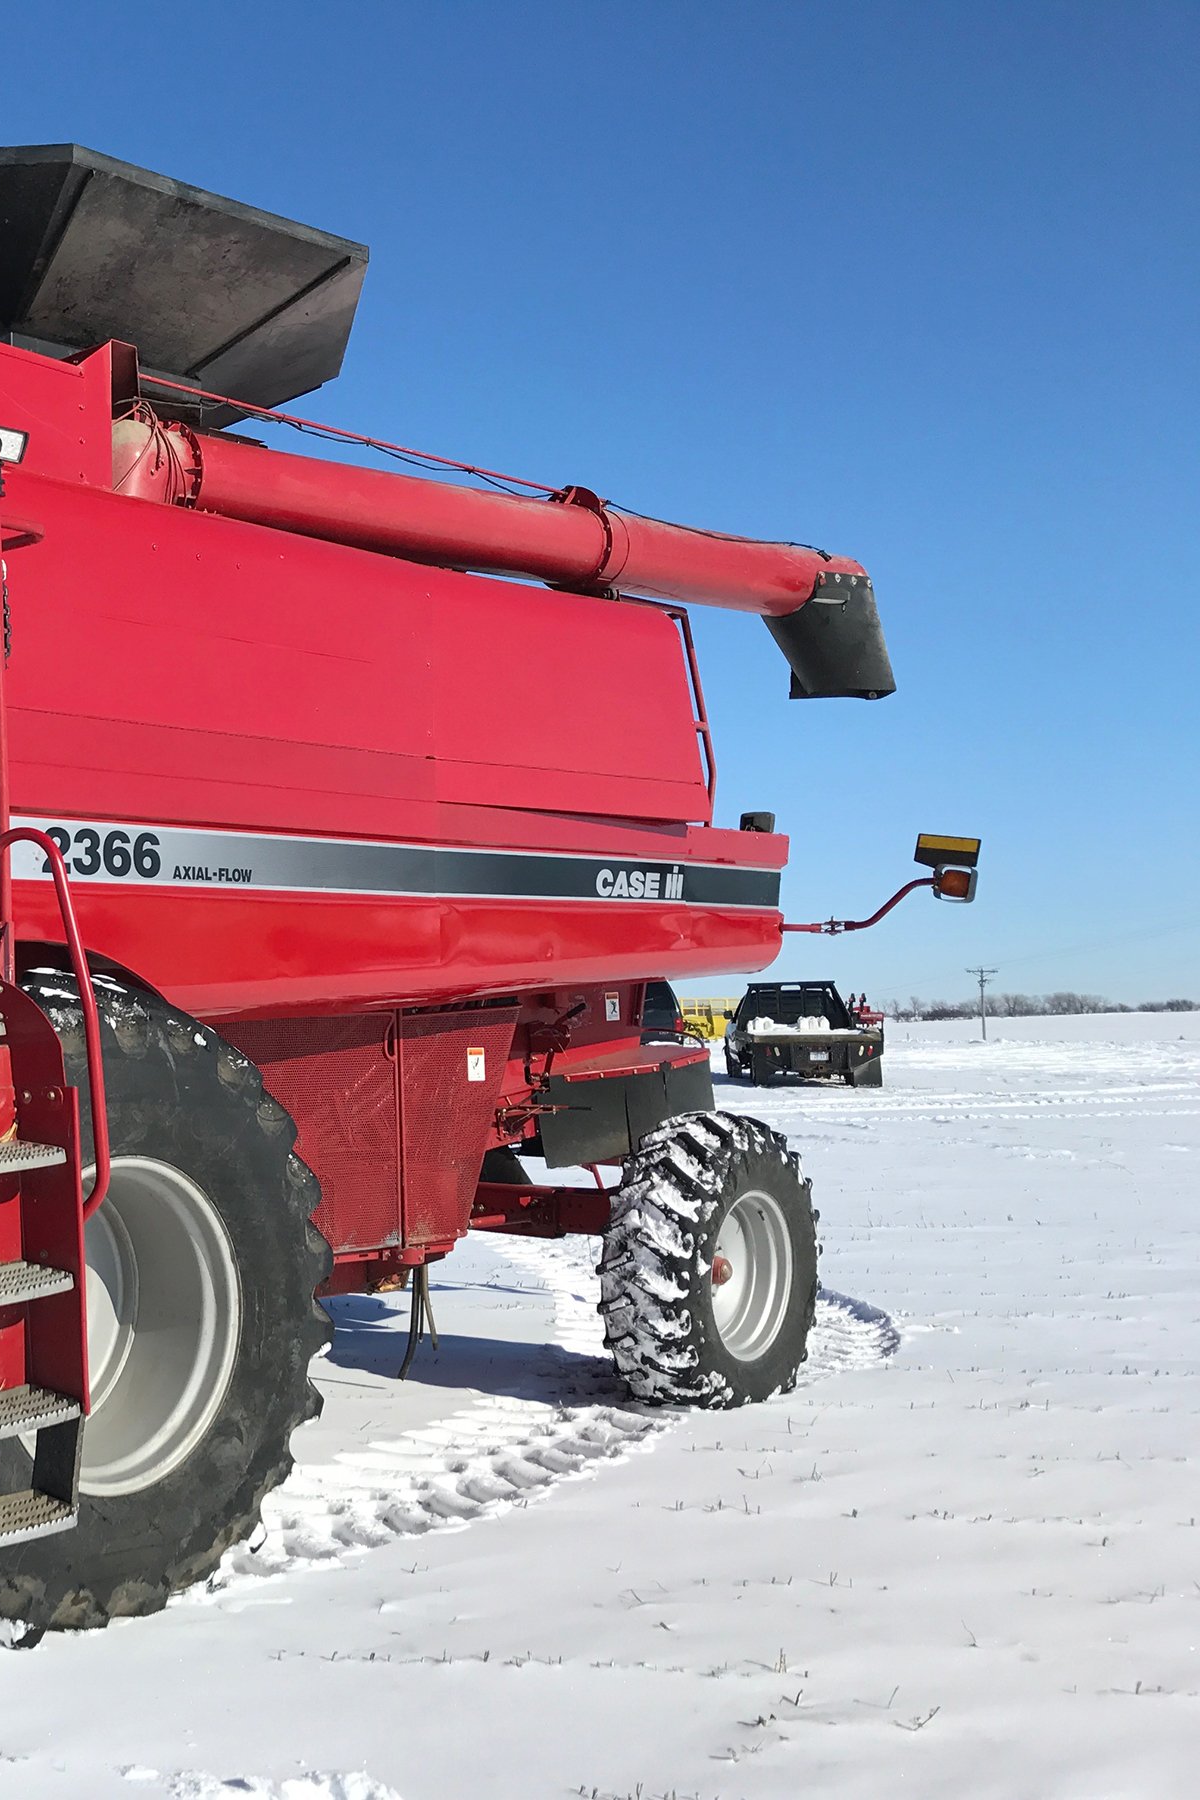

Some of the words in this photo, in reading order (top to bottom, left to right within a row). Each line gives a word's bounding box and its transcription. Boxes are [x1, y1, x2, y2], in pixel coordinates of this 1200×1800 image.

[42, 826, 161, 879] 2366
[172, 866, 253, 883] AXIAL-FLOW
[596, 868, 660, 899] CASE
